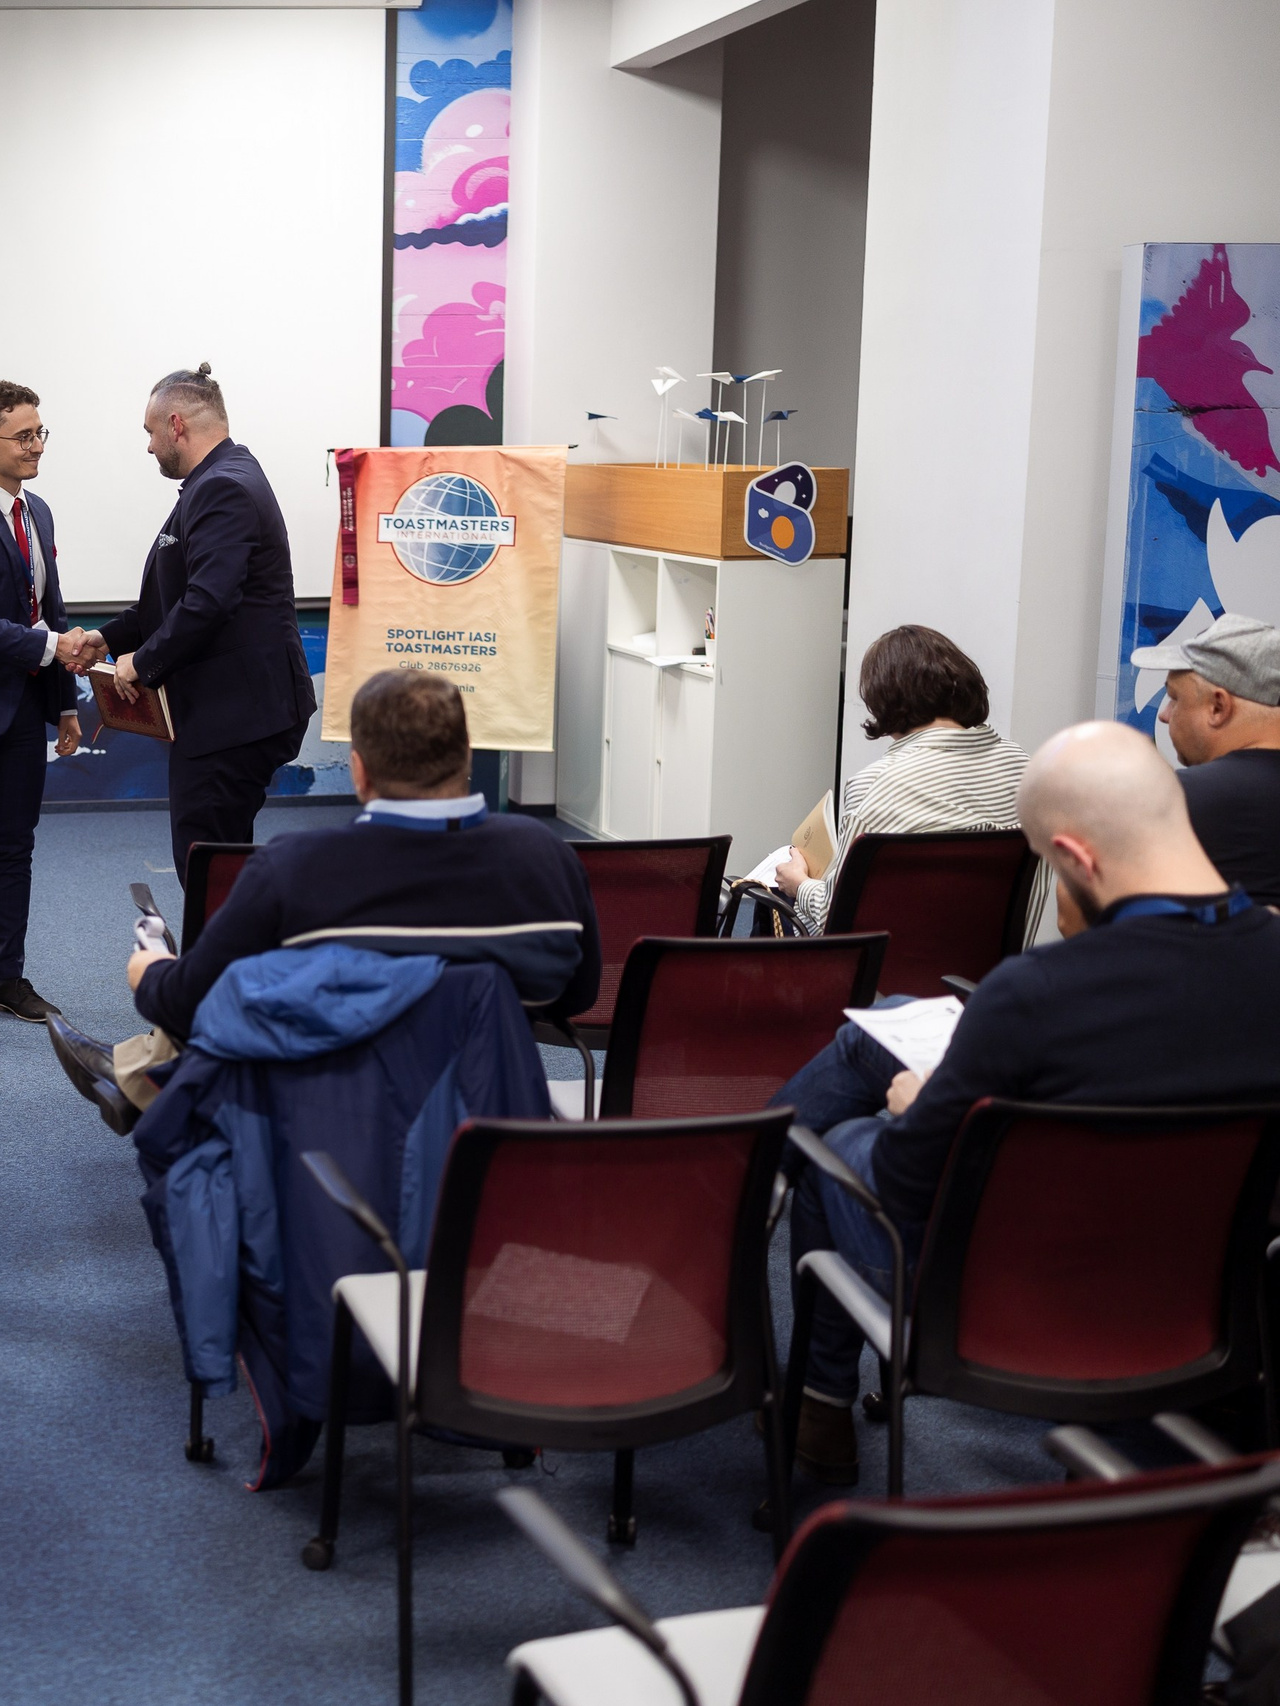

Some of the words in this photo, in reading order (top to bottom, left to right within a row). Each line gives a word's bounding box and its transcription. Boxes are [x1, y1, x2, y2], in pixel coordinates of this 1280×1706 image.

[384, 517, 510, 532] TOASTMASTERS
[396, 530, 495, 541] INTERNATIONAL
[387, 628, 465, 642] SPOTLIGHT
[469, 631, 496, 643] IASI
[385, 642, 497, 656] TOASTMASTERS
[399, 660, 424, 670] Club
[427, 661, 482, 673] 28676926
